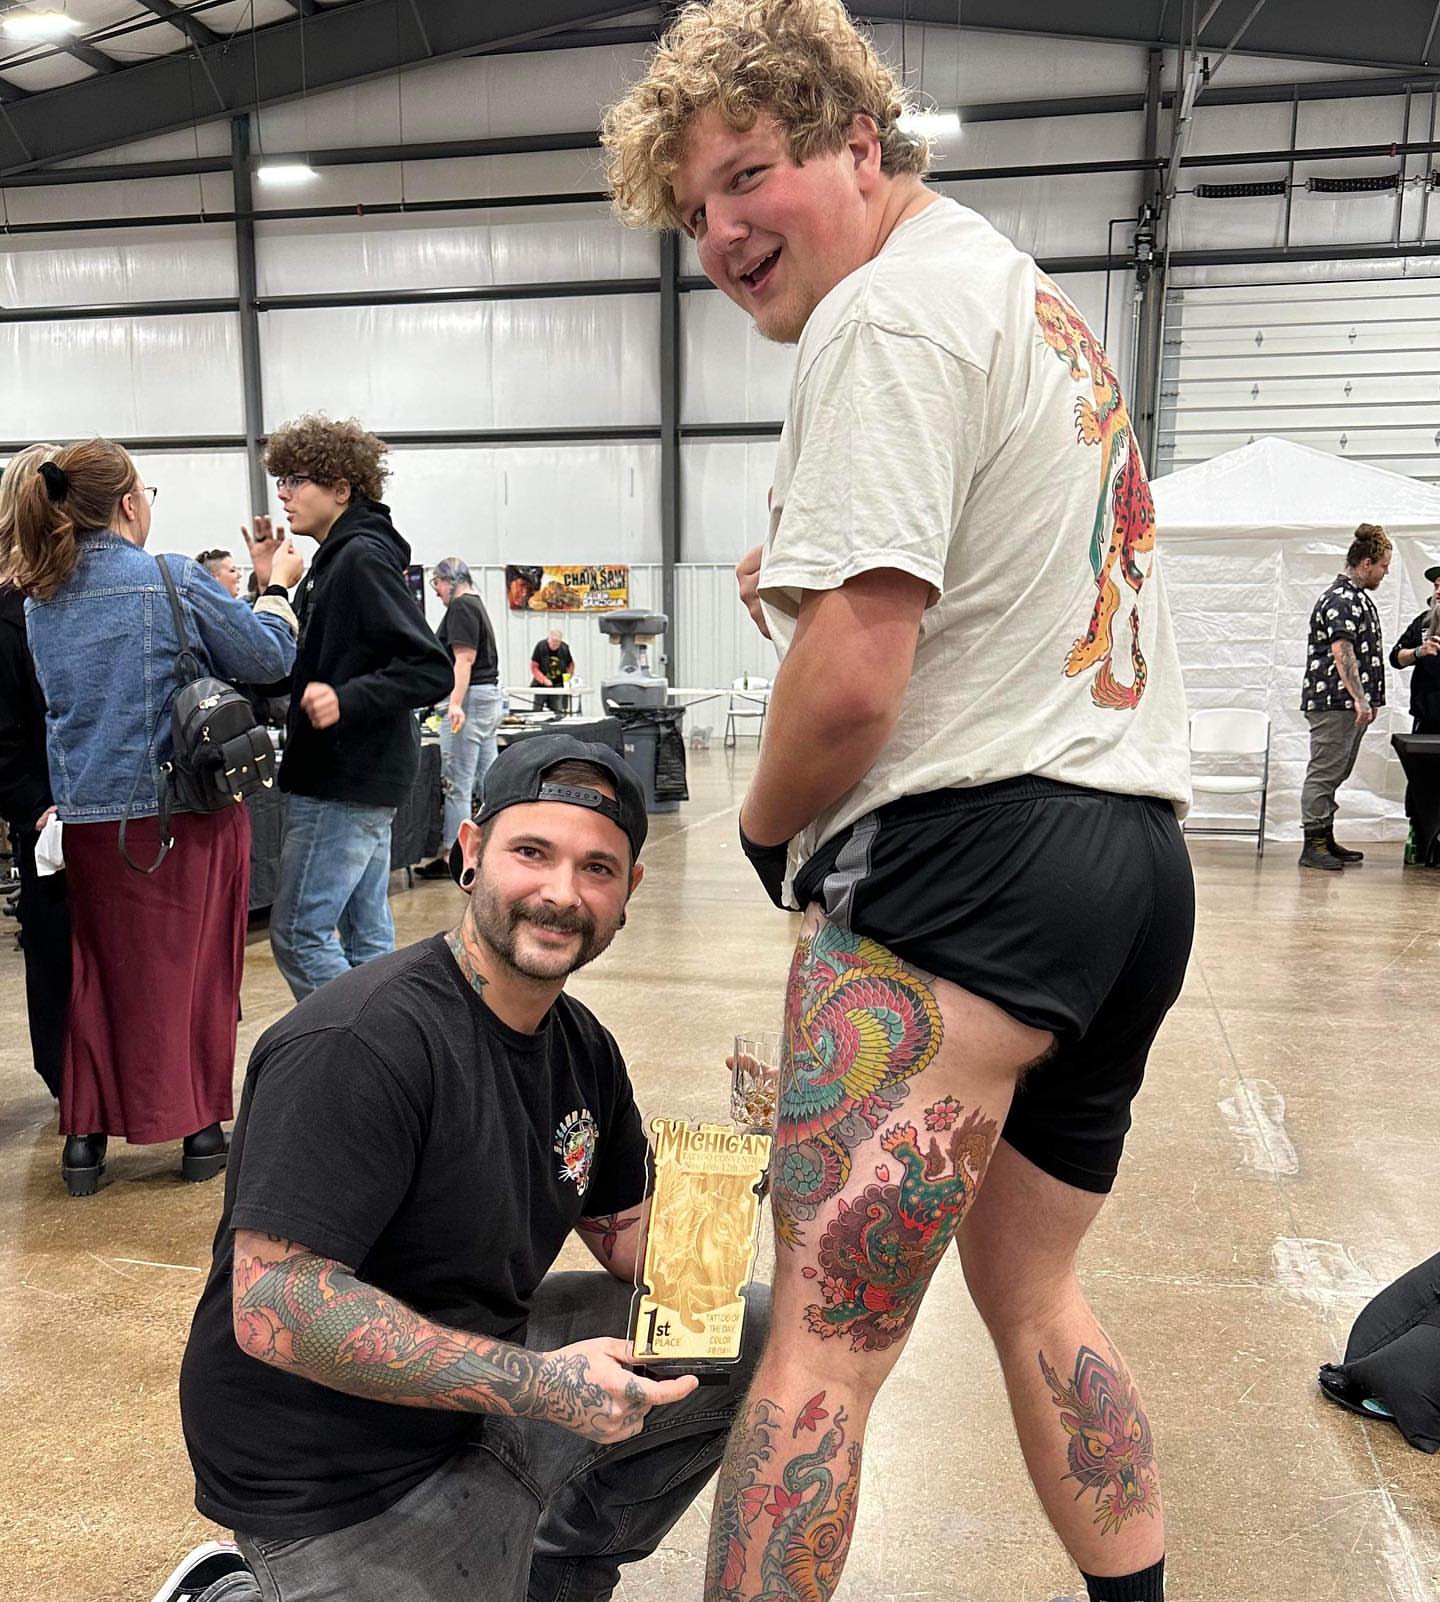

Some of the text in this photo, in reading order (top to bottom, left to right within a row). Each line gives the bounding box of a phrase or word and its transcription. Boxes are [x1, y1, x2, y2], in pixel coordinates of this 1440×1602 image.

[564, 568, 625, 586] CHAIN SAW
[655, 1119, 769, 1164] MICHIGAN
[706, 1313, 731, 1323] TATTOO
[654, 1337, 681, 1348] PLACE
[710, 1335, 731, 1345] COLOR
